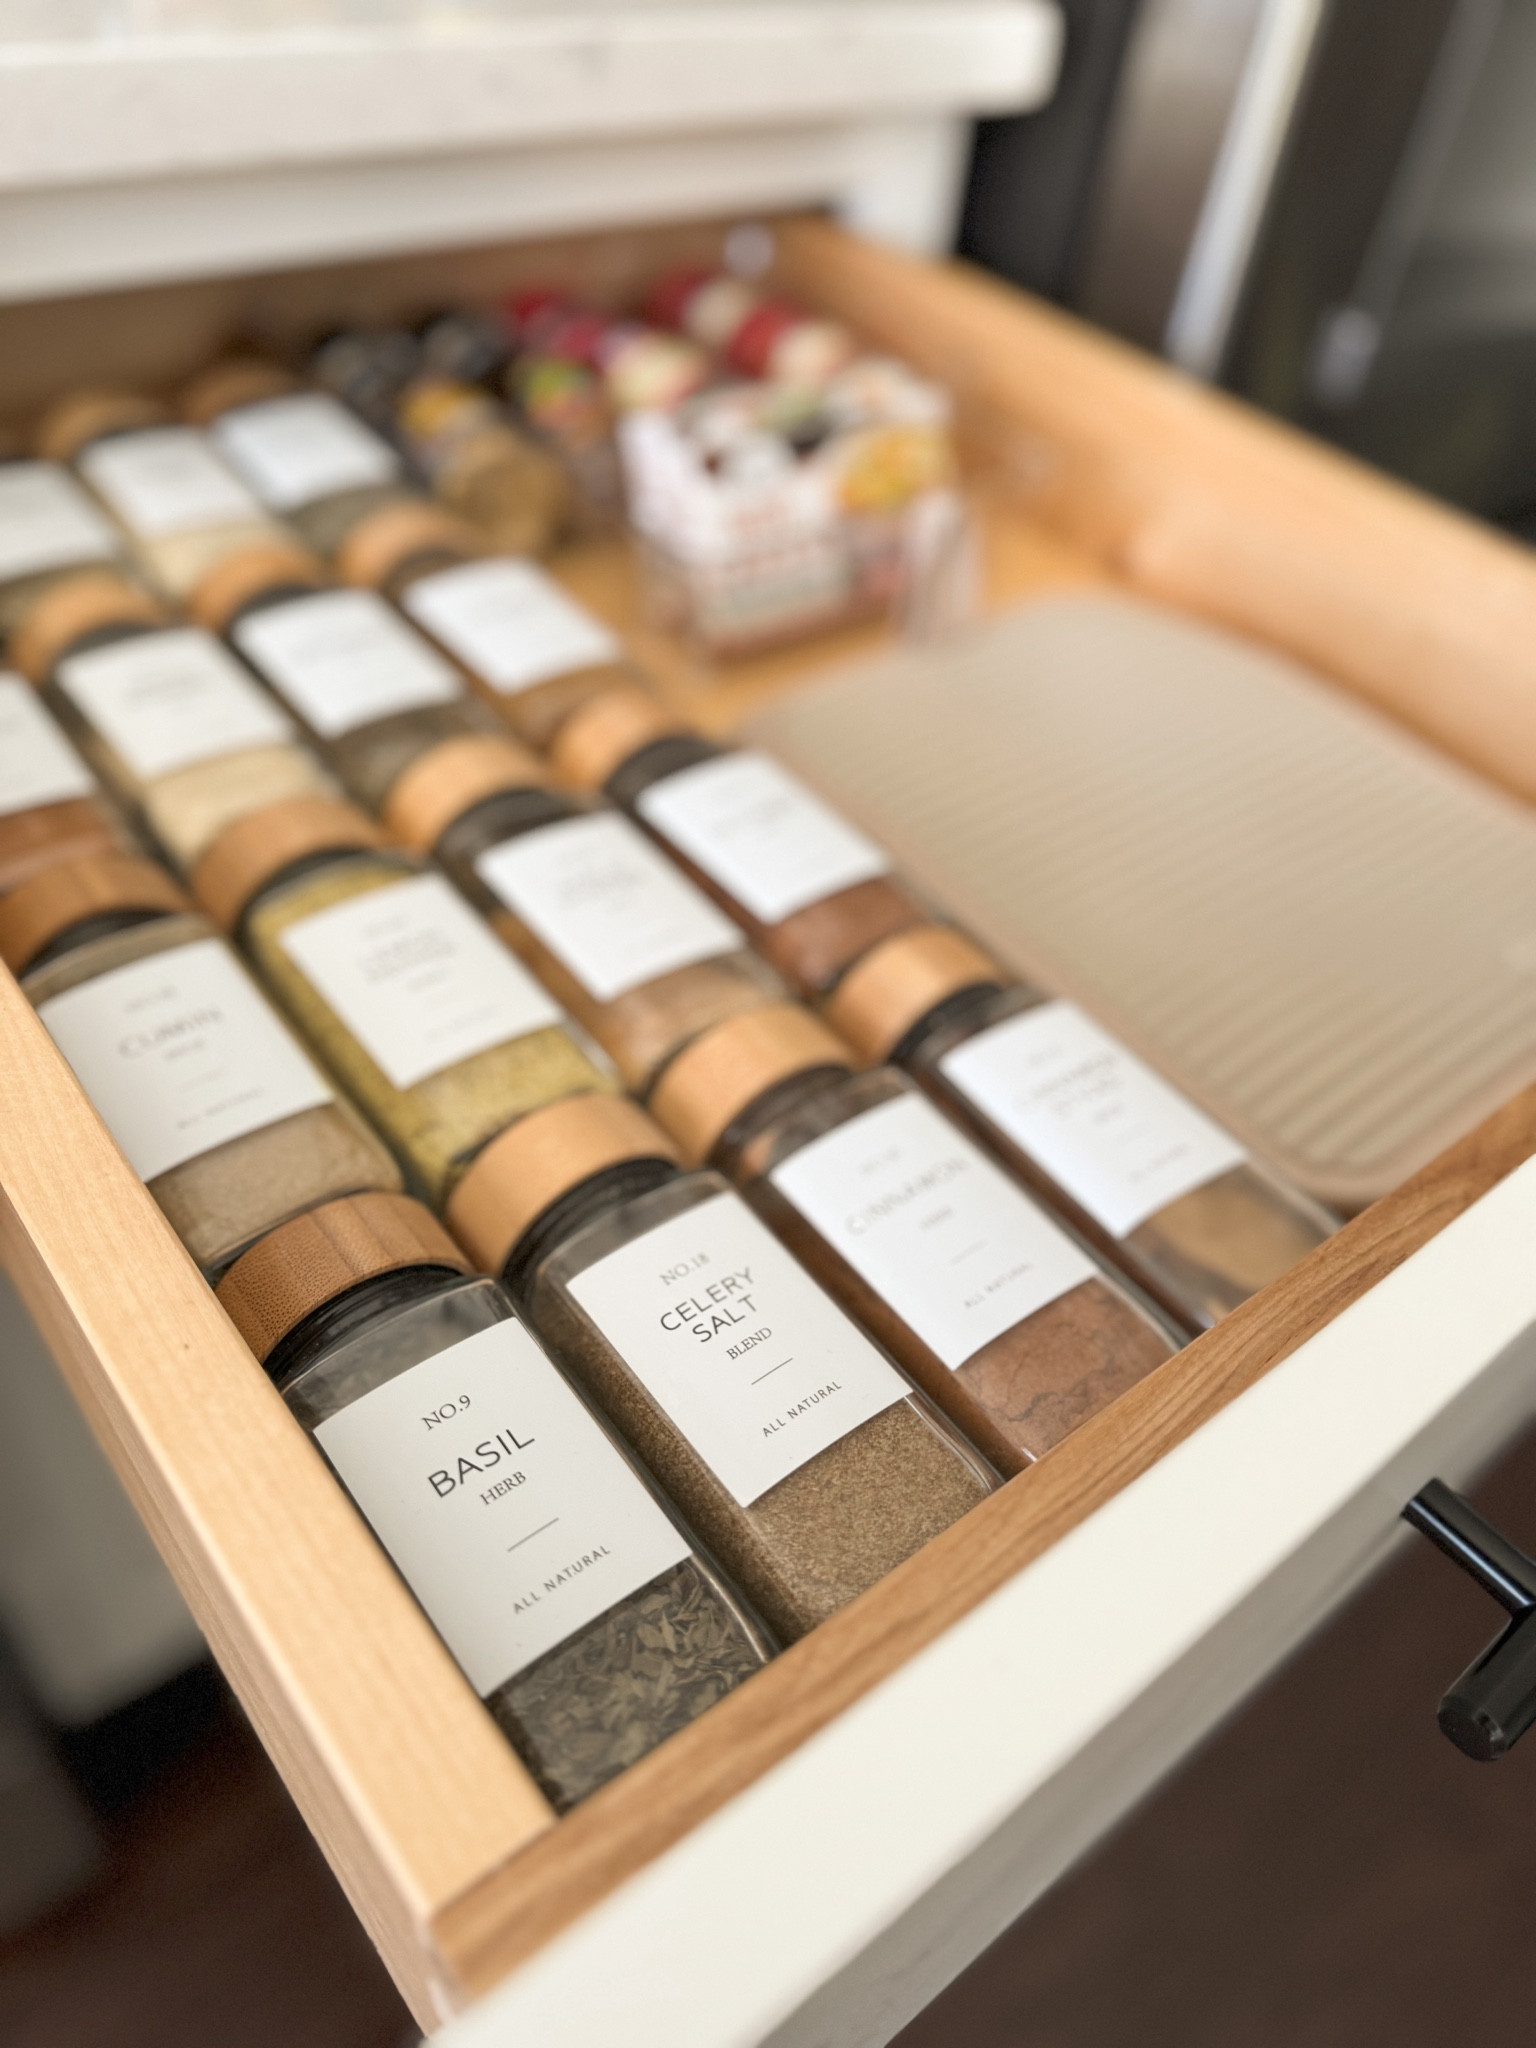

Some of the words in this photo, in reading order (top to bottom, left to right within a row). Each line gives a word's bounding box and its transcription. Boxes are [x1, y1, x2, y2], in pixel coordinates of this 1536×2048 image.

[659, 1266, 756, 1332] CELERY
[692, 1294, 758, 1343] SALT
[726, 1326, 773, 1360] BLEND
[421, 1394, 472, 1431] NO.9
[762, 1418, 787, 1438] ALL
[786, 1380, 843, 1420] NATURAL
[427, 1427, 536, 1498] BASIL
[479, 1471, 527, 1506] HERB
[512, 1592, 542, 1615] ALL
[543, 1545, 611, 1592] NATURAL
